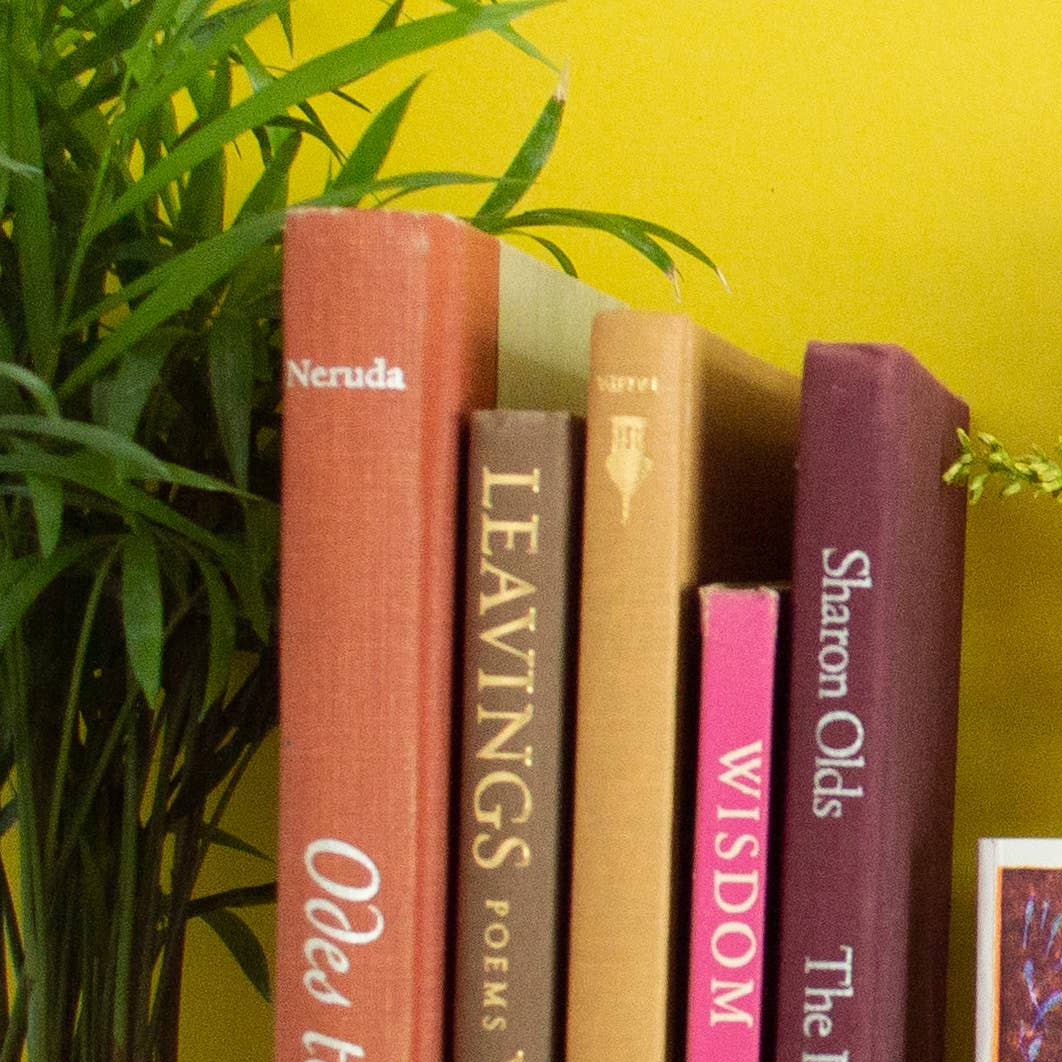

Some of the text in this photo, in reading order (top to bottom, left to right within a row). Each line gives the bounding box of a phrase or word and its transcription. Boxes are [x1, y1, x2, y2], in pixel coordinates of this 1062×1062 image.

[286, 358, 406, 391] Neruda
[472, 467, 541, 870] LEAVINGS
[811, 548, 872, 820] Sharon Olds
[303, 838, 385, 1008] Odes
[484, 900, 509, 1031] POEMS
[709, 740, 764, 1028] WISDOM
[804, 944, 853, 1038] The
